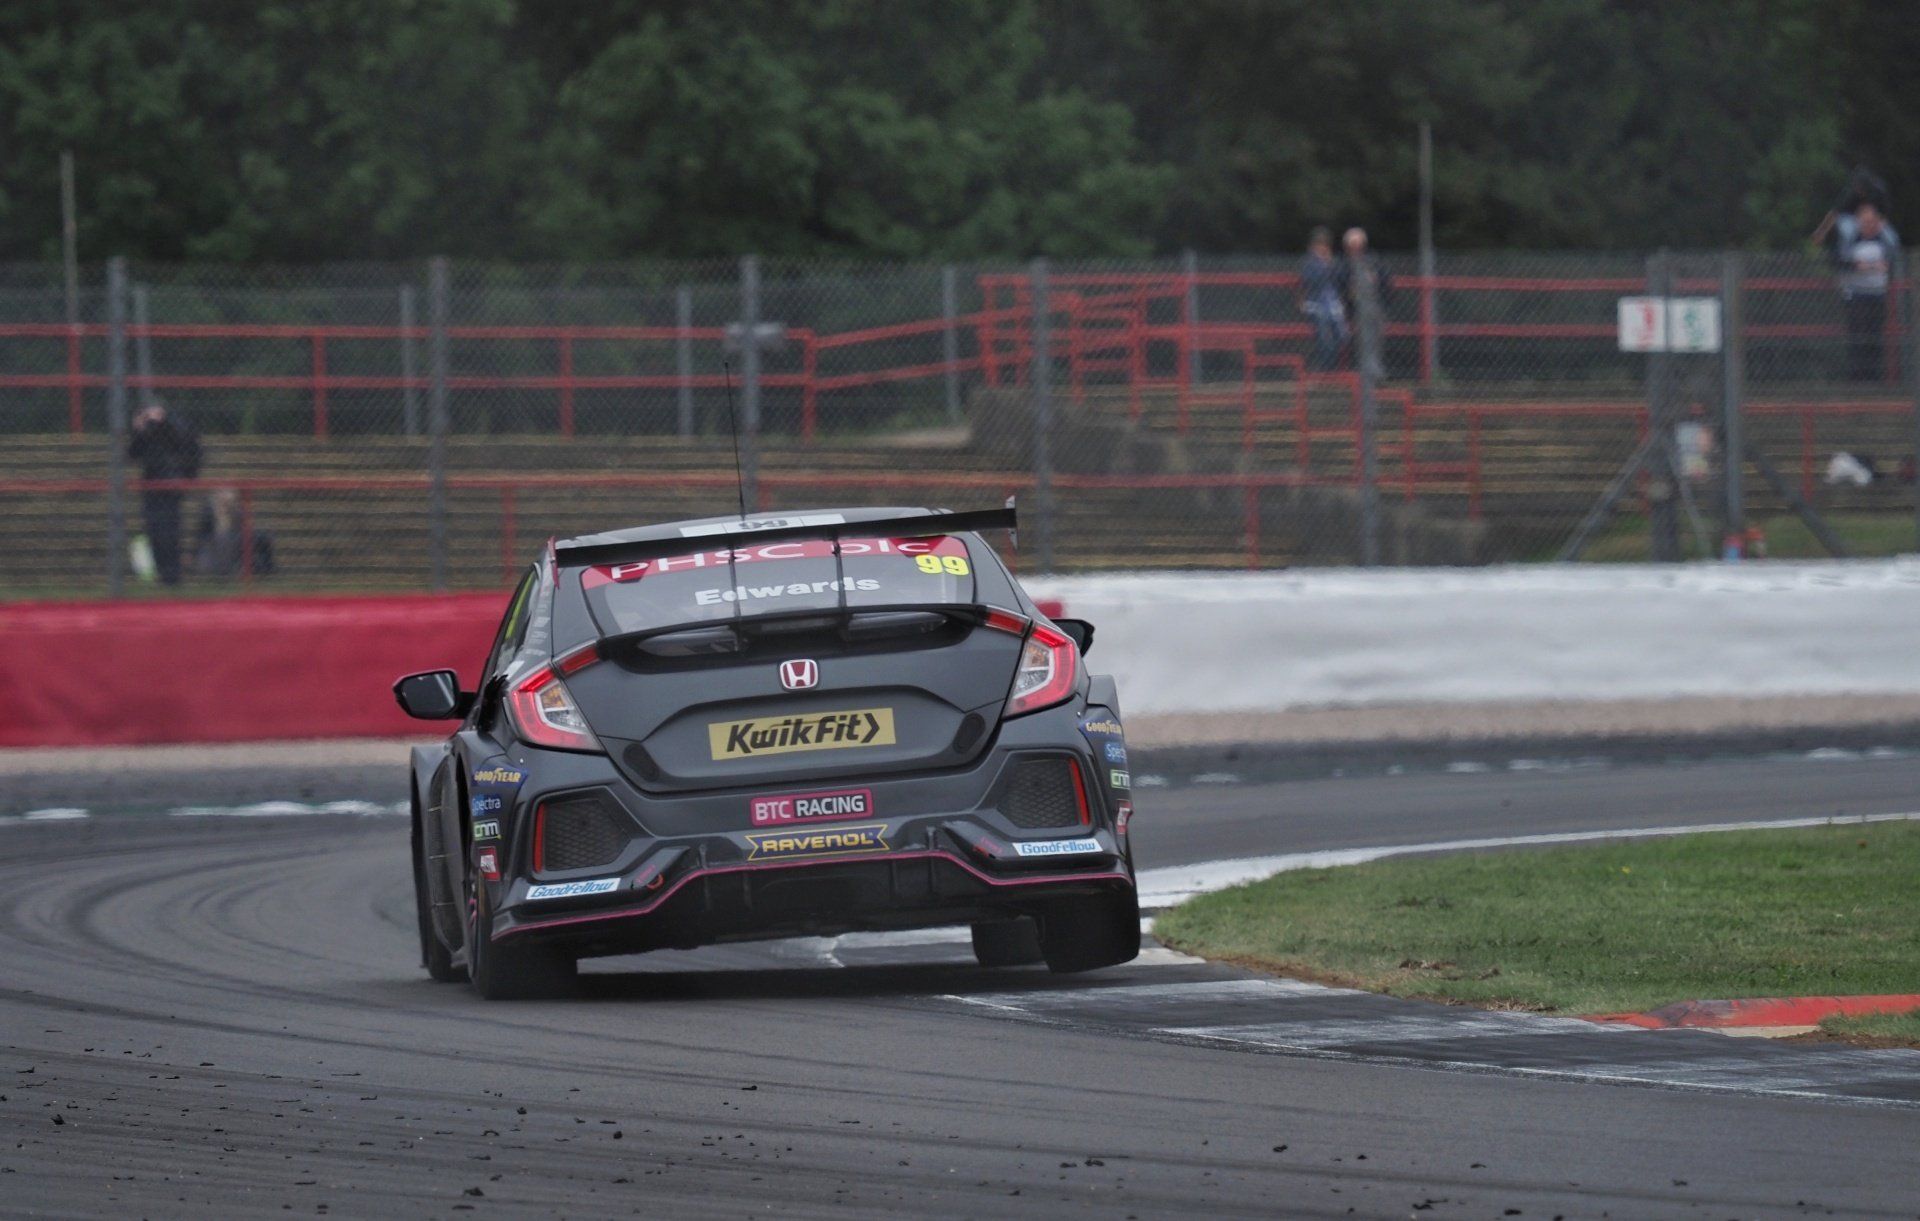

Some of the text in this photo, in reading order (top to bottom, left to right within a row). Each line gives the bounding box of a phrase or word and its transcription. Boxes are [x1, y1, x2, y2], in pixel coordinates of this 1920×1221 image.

[611, 543, 805, 580] PHSC
[915, 554, 970, 576] 99
[694, 576, 881, 606] Edwards
[755, 795, 865, 821] BTC RACING
[762, 832, 874, 853] RAVENOL
